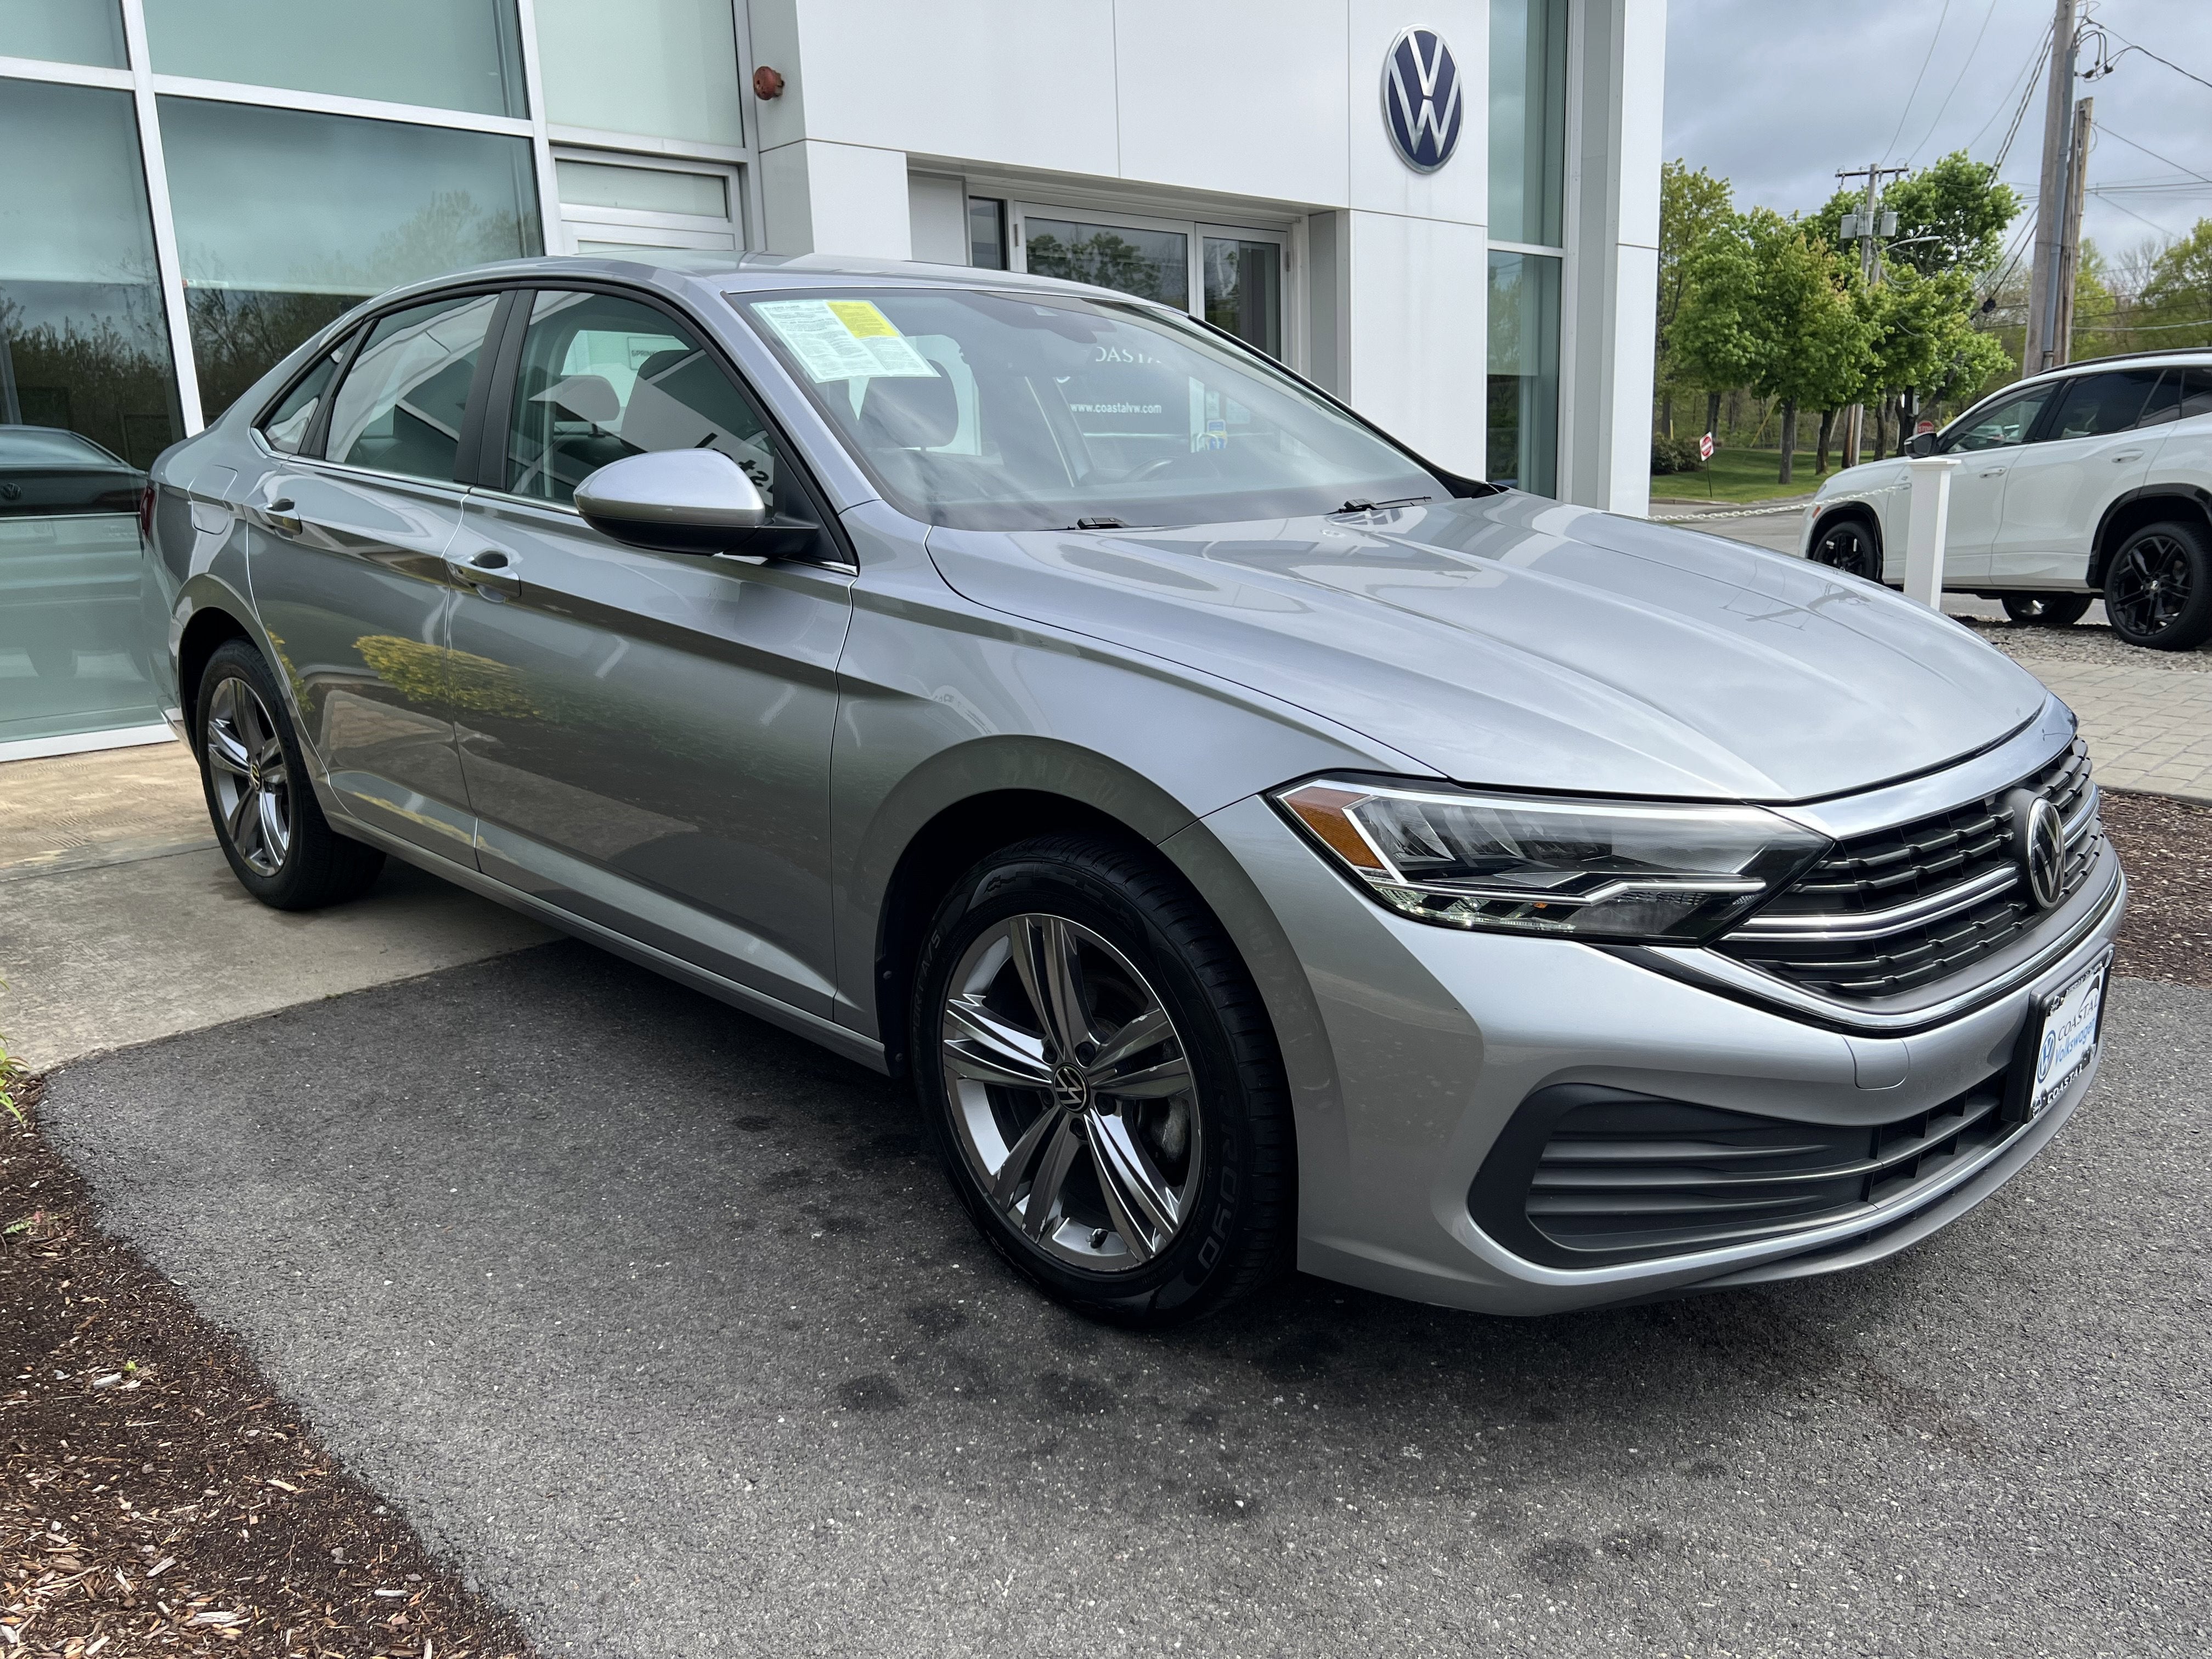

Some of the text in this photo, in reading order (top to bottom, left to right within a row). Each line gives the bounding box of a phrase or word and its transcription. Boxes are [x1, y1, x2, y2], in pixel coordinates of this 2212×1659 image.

[1384, 26, 1464, 172] VW
[1070, 402, 1162, 413] www.coastalvw.com
[2058, 995, 2097, 1041] COASTAL
[2055, 1018, 2095, 1066] Volkswagen
[1054, 1066, 1086, 1111] VW
[2047, 1064, 2083, 1104] COASTAL
